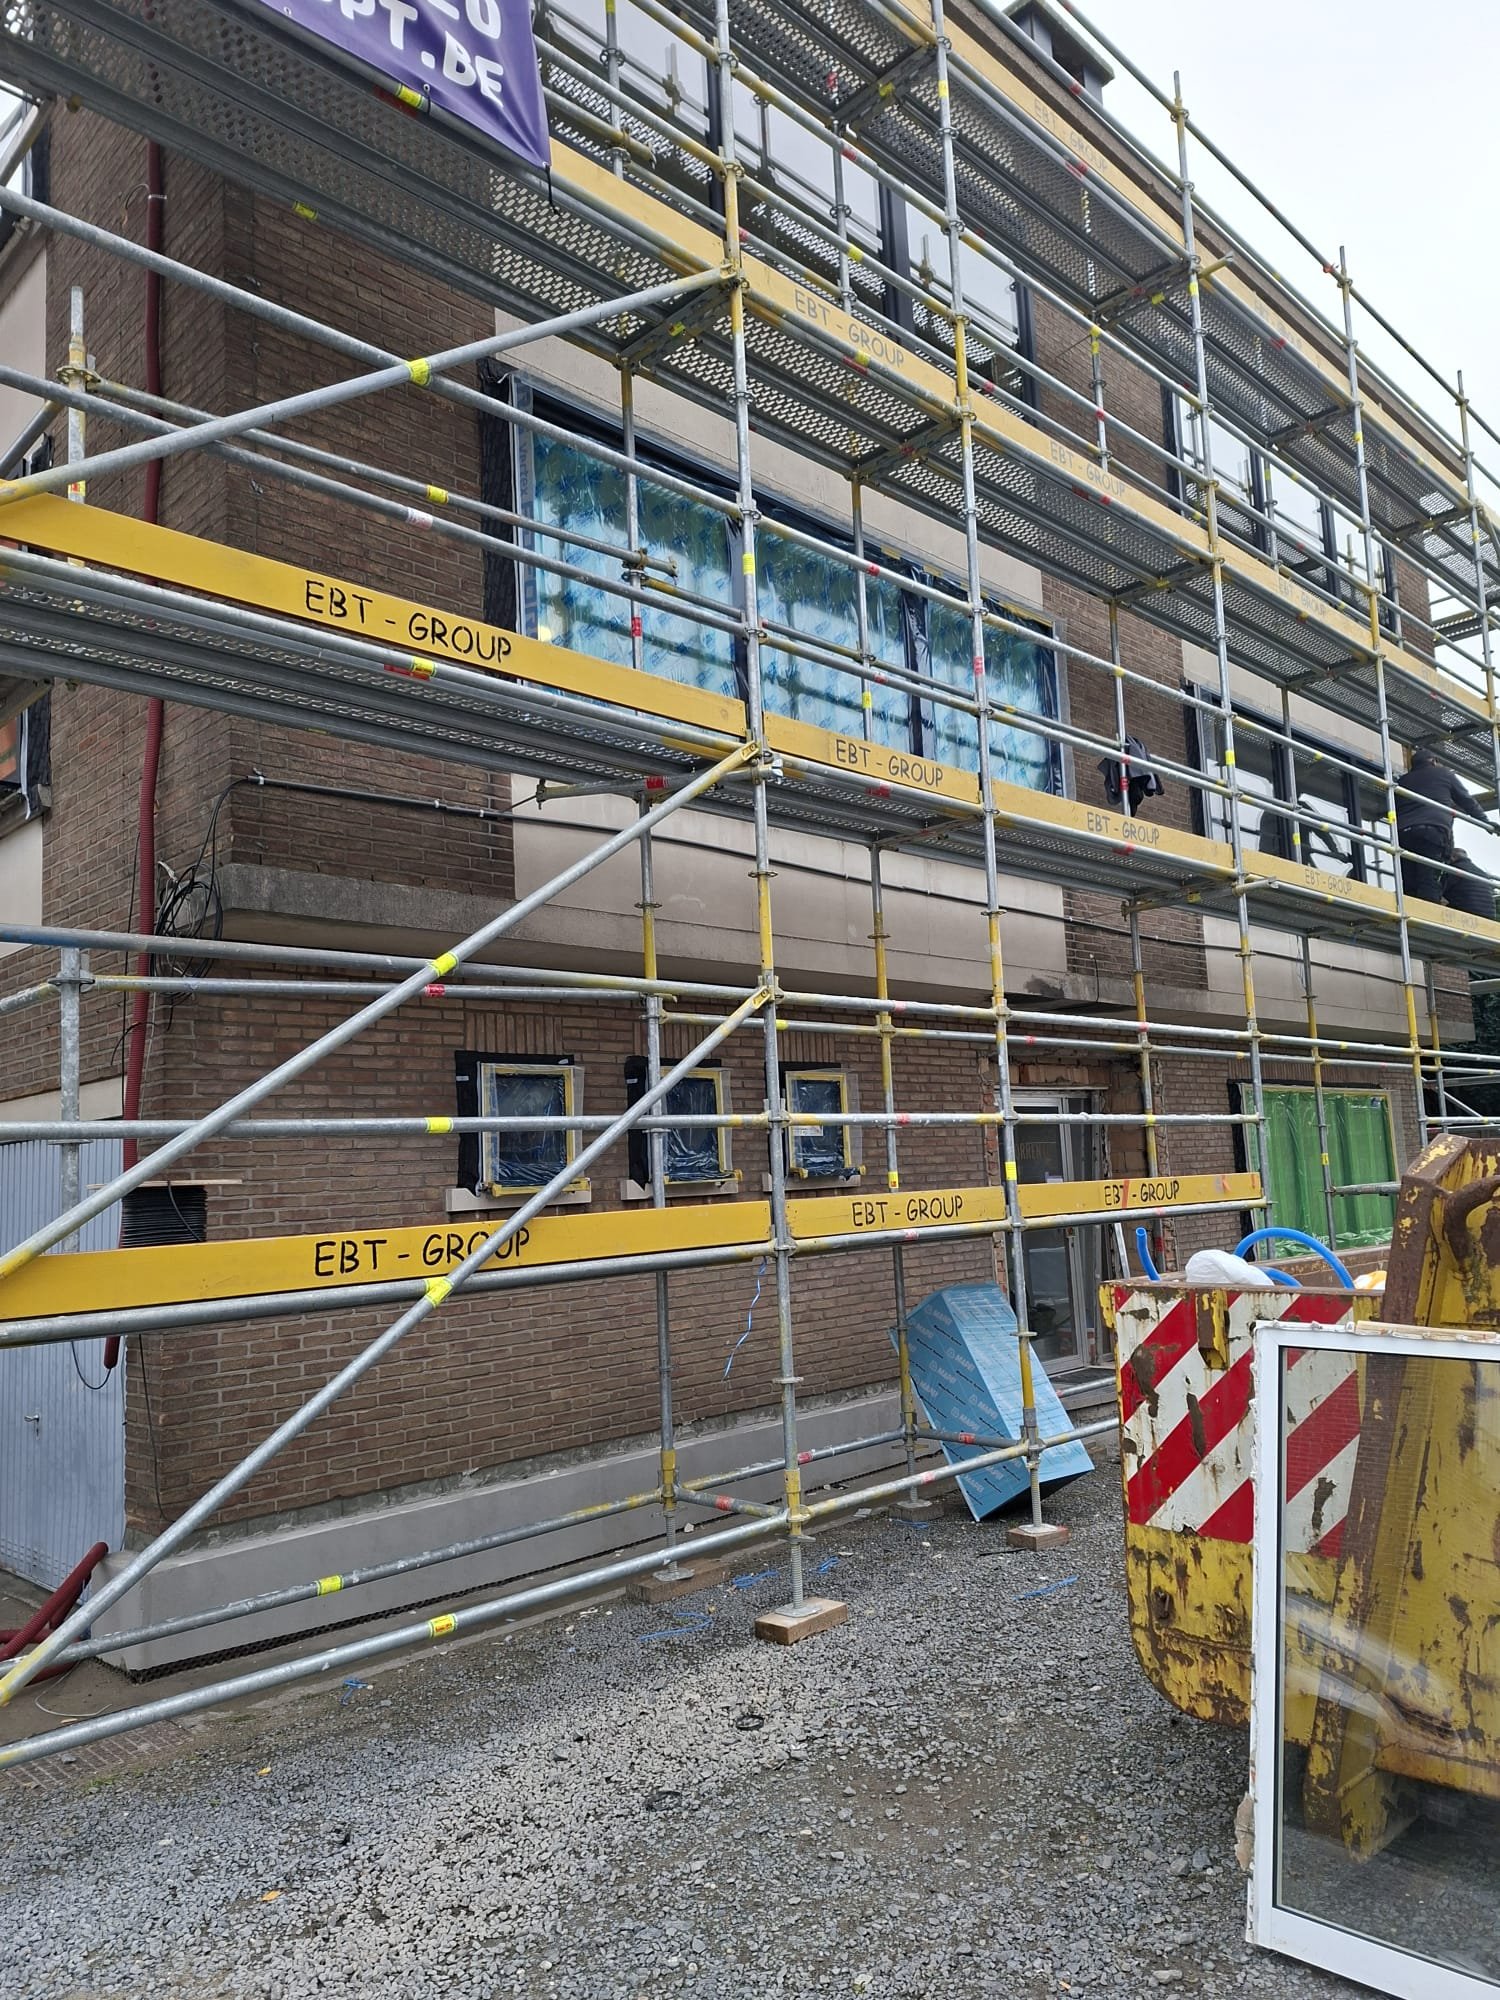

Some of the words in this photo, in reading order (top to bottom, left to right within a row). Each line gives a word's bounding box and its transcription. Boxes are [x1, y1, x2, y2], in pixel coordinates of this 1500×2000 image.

[320, 0, 504, 107] T.BE
[795, 289, 831, 326] EBT
[848, 323, 905, 368] GROUP
[1050, 440, 1073, 468] EBT
[1086, 463, 1126, 497] GROUP
[306, 579, 373, 624] EBT
[408, 612, 512, 663] GROUP
[835, 738, 871, 768] EBT
[888, 755, 944, 787] GROUP
[1087, 811, 1111, 833] EBT
[1122, 820, 1160, 846] GROUP
[852, 1201, 888, 1226] EBT
[906, 1195, 963, 1221] GROUP
[1140, 1180, 1180, 1203] GROUP
[315, 1239, 387, 1276] EBT
[422, 1227, 530, 1266] GROUP
